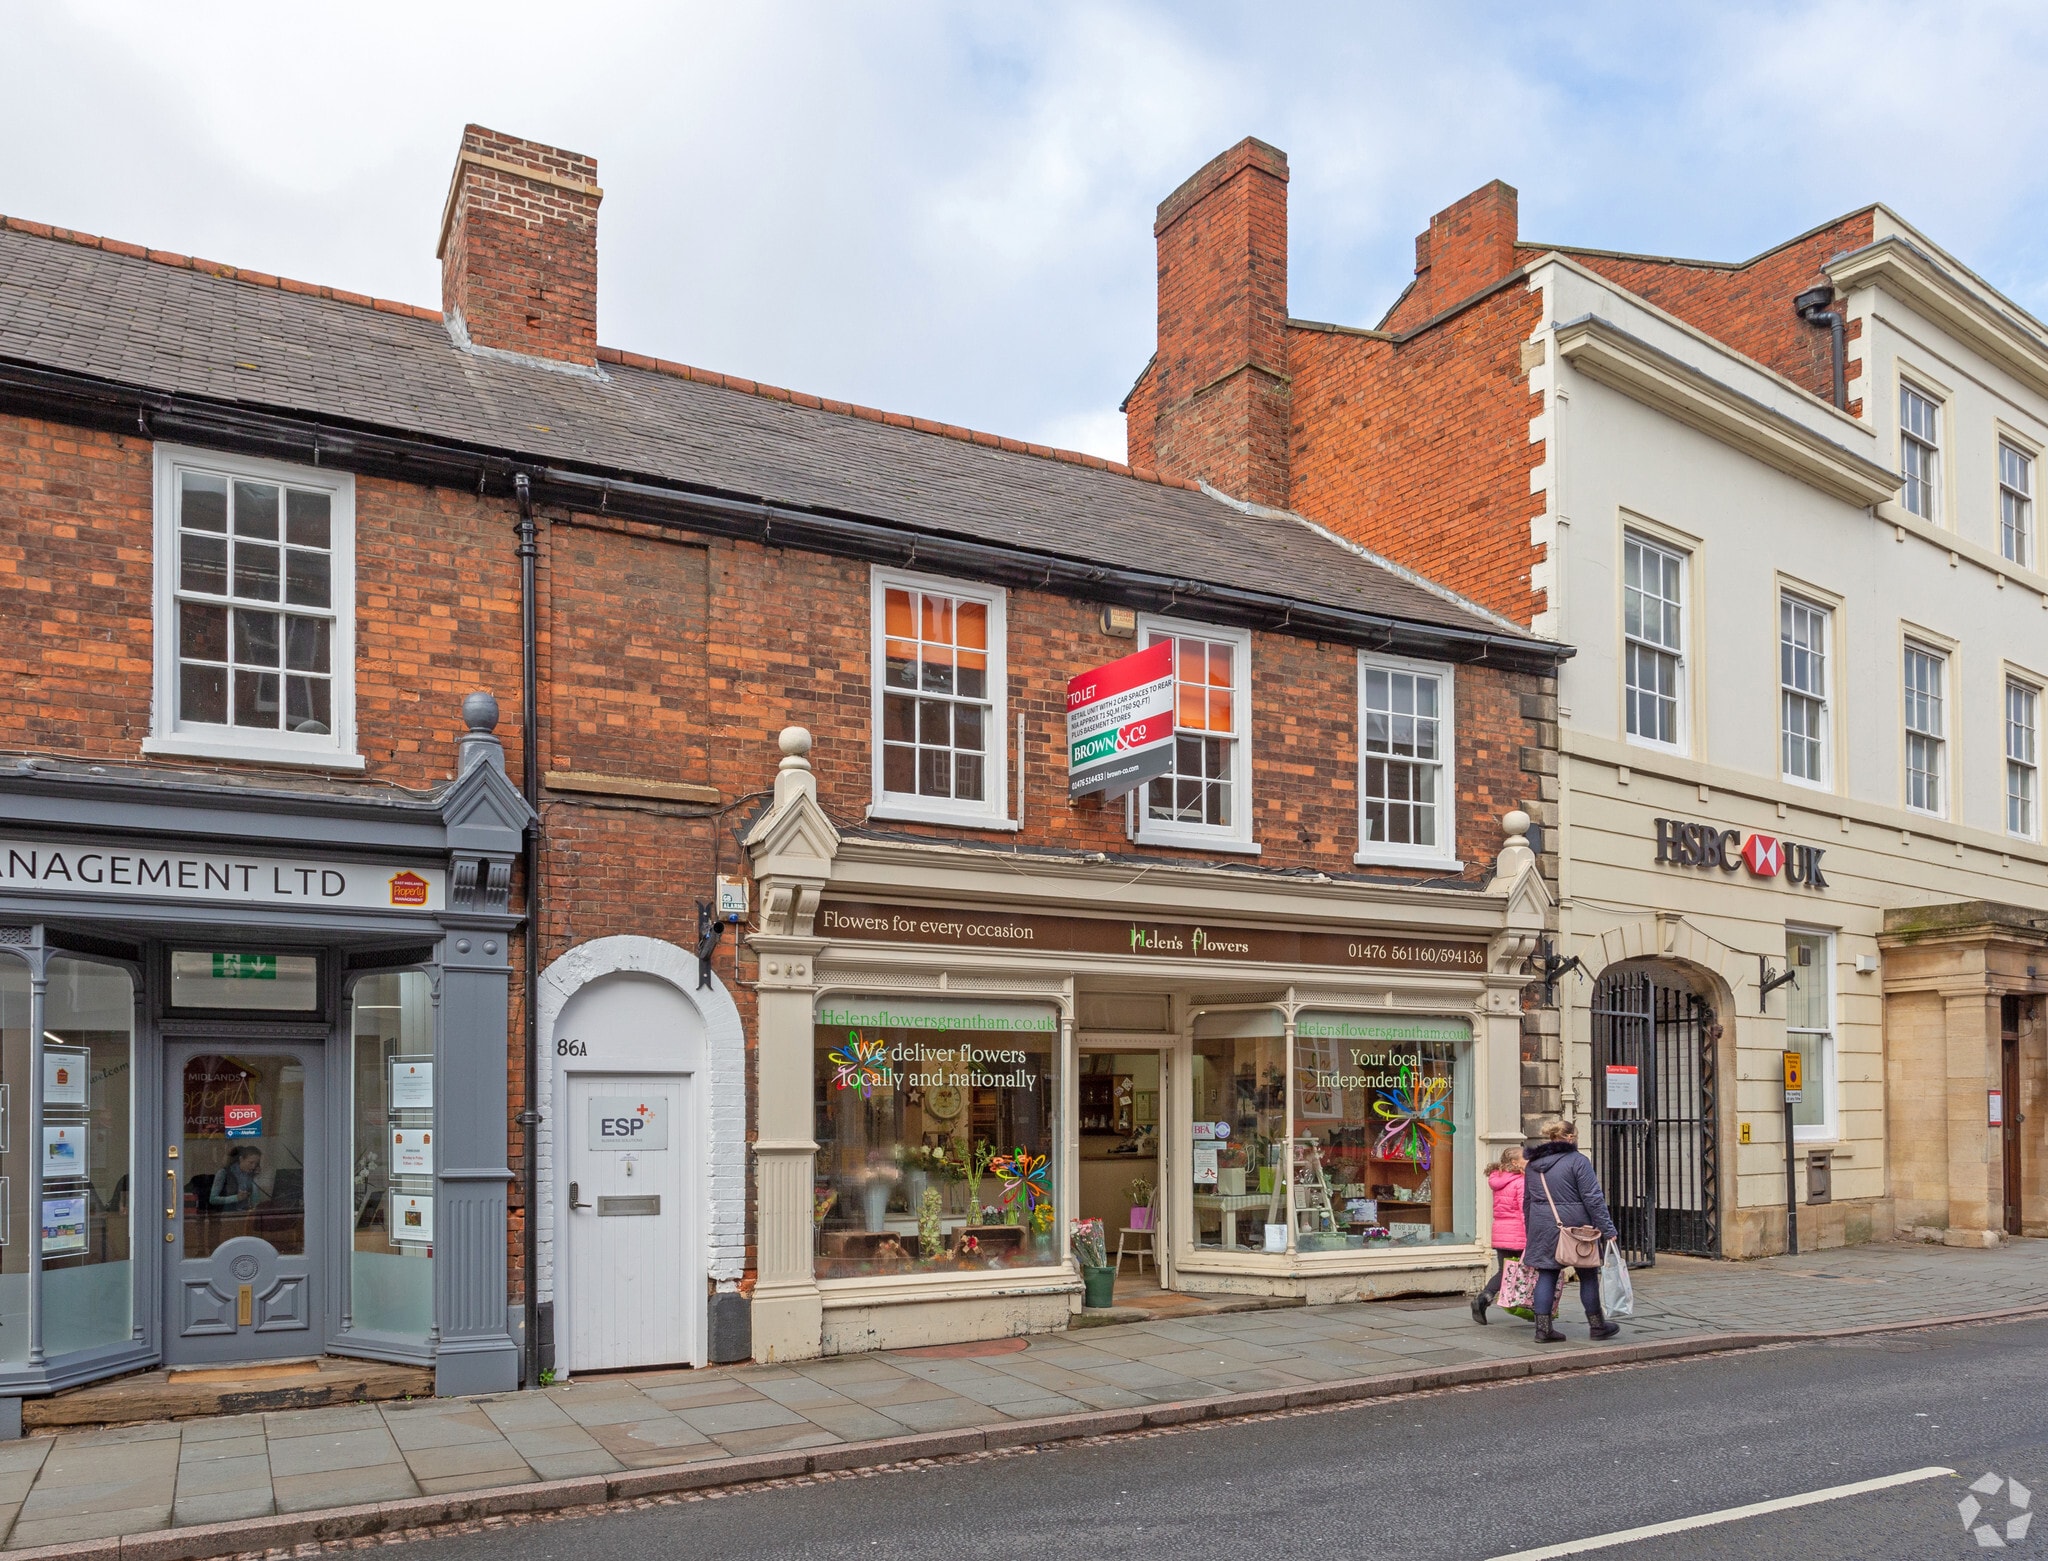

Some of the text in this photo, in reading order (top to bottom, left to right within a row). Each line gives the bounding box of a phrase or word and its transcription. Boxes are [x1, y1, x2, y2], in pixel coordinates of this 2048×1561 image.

[1070, 684, 1097, 705] TO LET
[1071, 710, 1086, 722] RETAIL
[1087, 705, 1099, 715] UNIT
[1099, 701, 1113, 711] WITH
[1117, 695, 1128, 705] CAR
[1128, 687, 1149, 701] SPACES
[1149, 685, 1157, 693] TO
[1157, 679, 1173, 691] REAR
[1071, 712, 1131, 739] PLUS BASEMENT STORES
[1080, 714, 1099, 727] APPROX
[1106, 764, 1140, 779] brown-co.com
[1654, 817, 1830, 887] HSBC UK
[0, 848, 346, 897] NAGEMENT LTD
[393, 885, 425, 899] Property
[823, 911, 1034, 940] Flowers for every occasion
[1130, 922, 1249, 956] Helen's Flowers
[1348, 943, 1483, 965] 01476 561160/594136
[821, 1009, 1056, 1032] Helensflowersgrantham.co.uk
[557, 1039, 588, 1056] 86A
[853, 1042, 1027, 1064] We deliver flowers
[1350, 1049, 1421, 1067] Your local
[188, 1073, 241, 1082] MIDLANDS
[841, 1068, 1037, 1092] locally and nationally
[1316, 1071, 1453, 1090] Independent Florist
[229, 1111, 257, 1120] open
[601, 1117, 644, 1136] ESP
[1194, 1125, 1211, 1134] BFA
